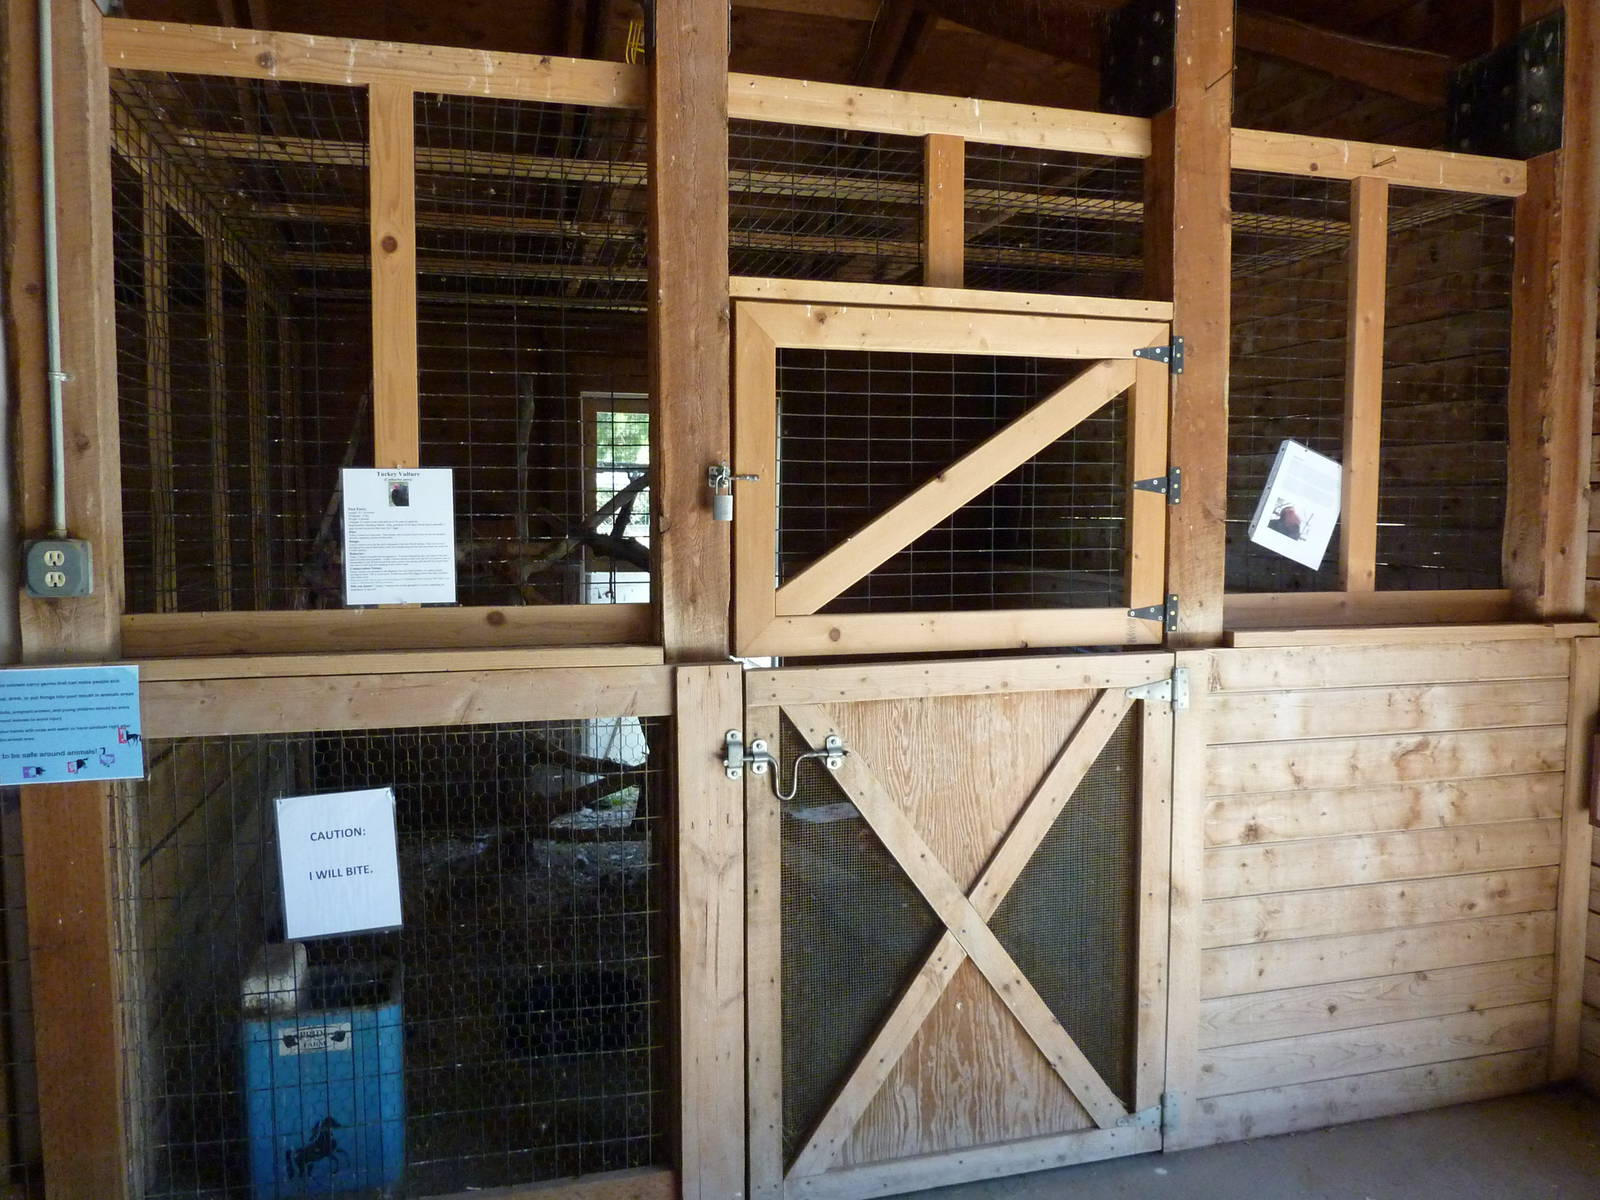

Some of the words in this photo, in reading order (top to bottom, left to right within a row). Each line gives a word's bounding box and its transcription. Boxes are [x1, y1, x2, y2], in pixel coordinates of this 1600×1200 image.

[39, 750, 65, 758] around
[66, 748, 97, 756] animals!
[310, 827, 366, 841] CAUTION:
[309, 871, 313, 881] I
[315, 868, 343, 880] WILL
[345, 864, 374, 877] BITE.
